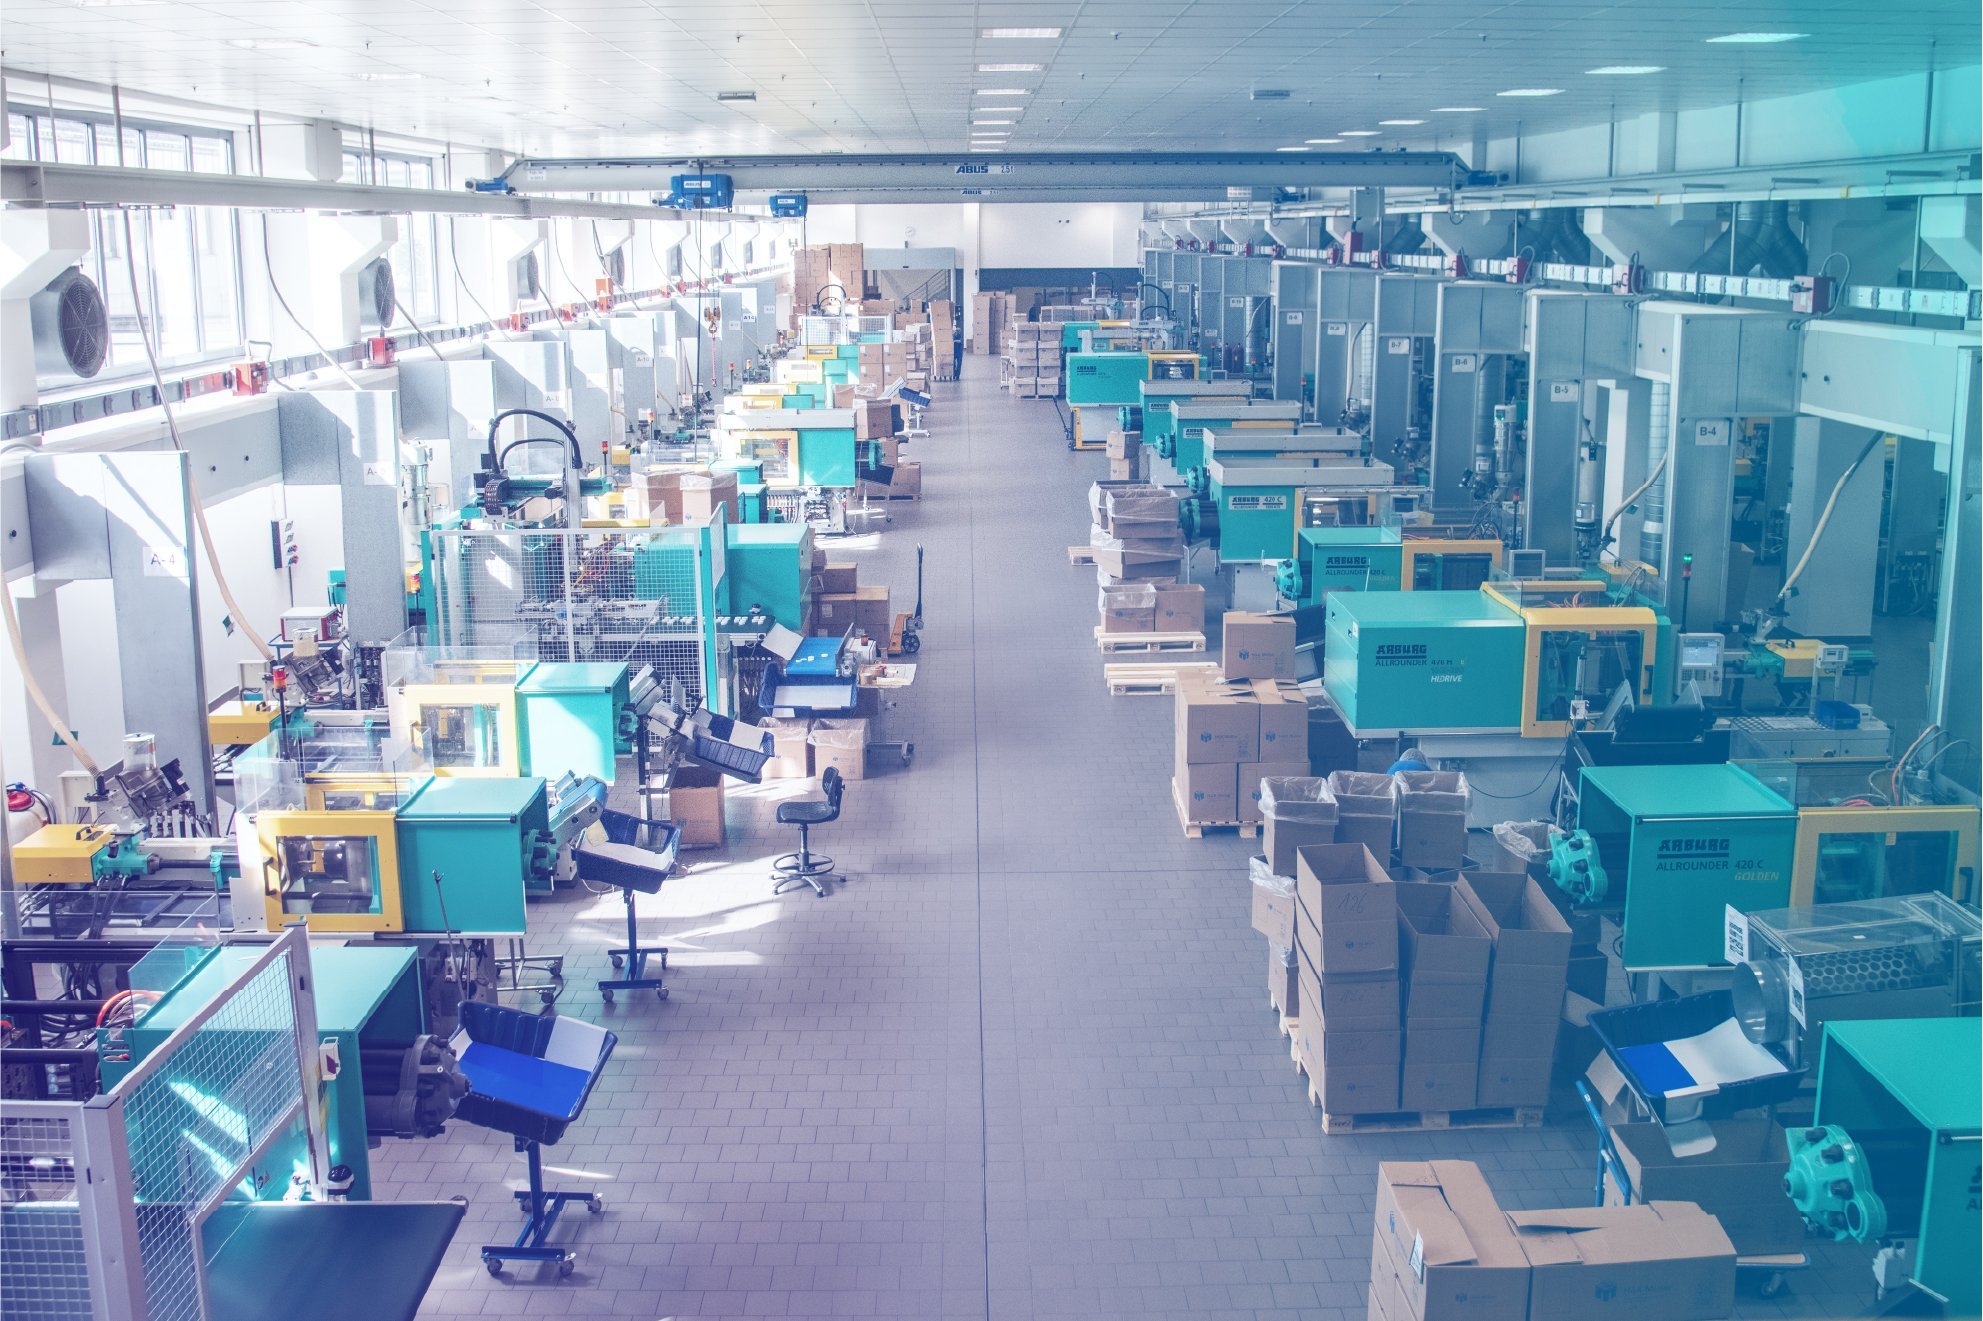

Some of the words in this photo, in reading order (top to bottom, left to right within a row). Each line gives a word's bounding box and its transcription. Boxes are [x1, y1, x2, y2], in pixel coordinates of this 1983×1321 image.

[956, 165, 989, 174] ABUS
[1554, 385, 1569, 394] B-5
[1699, 426, 1717, 437] B-4
[150, 553, 176, 566] A-4
[1326, 556, 1367, 565] ARBURG
[1376, 644, 1428, 655] ARBURG
[1375, 659, 1428, 667] ALLROUNDER
[1430, 674, 1464, 683] HIDRIVE
[1658, 838, 1731, 852] ARBURG
[1655, 860, 1730, 872] ALLROUNDER
[1734, 859, 1754, 870] 420
[1756, 859, 1765, 870] C
[1734, 871, 1780, 881] GOLDEN
